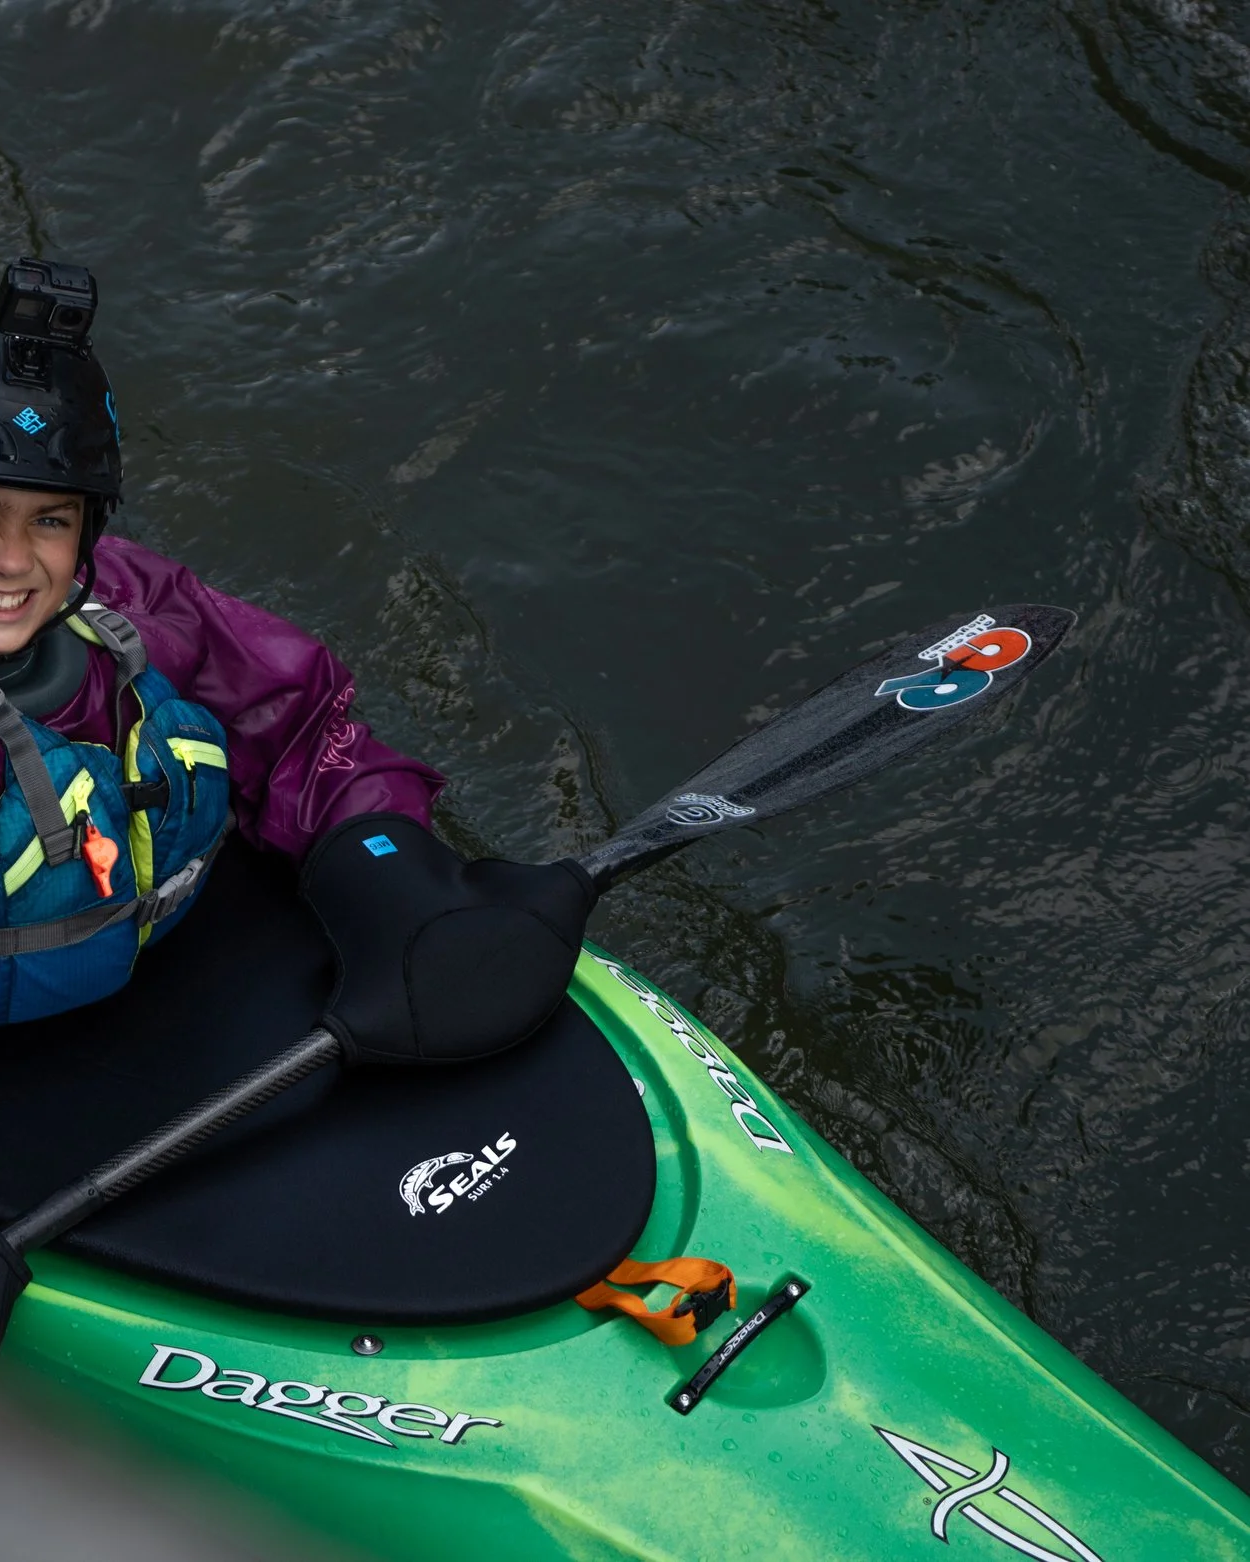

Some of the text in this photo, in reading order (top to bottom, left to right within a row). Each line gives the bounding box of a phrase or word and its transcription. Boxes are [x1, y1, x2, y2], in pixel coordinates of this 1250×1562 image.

[428, 1131, 517, 1214] SEALS
[468, 1166, 510, 1201] SURF 1.4
[718, 1310, 766, 1365] Dagger
[138, 1342, 504, 1449] Dagger
